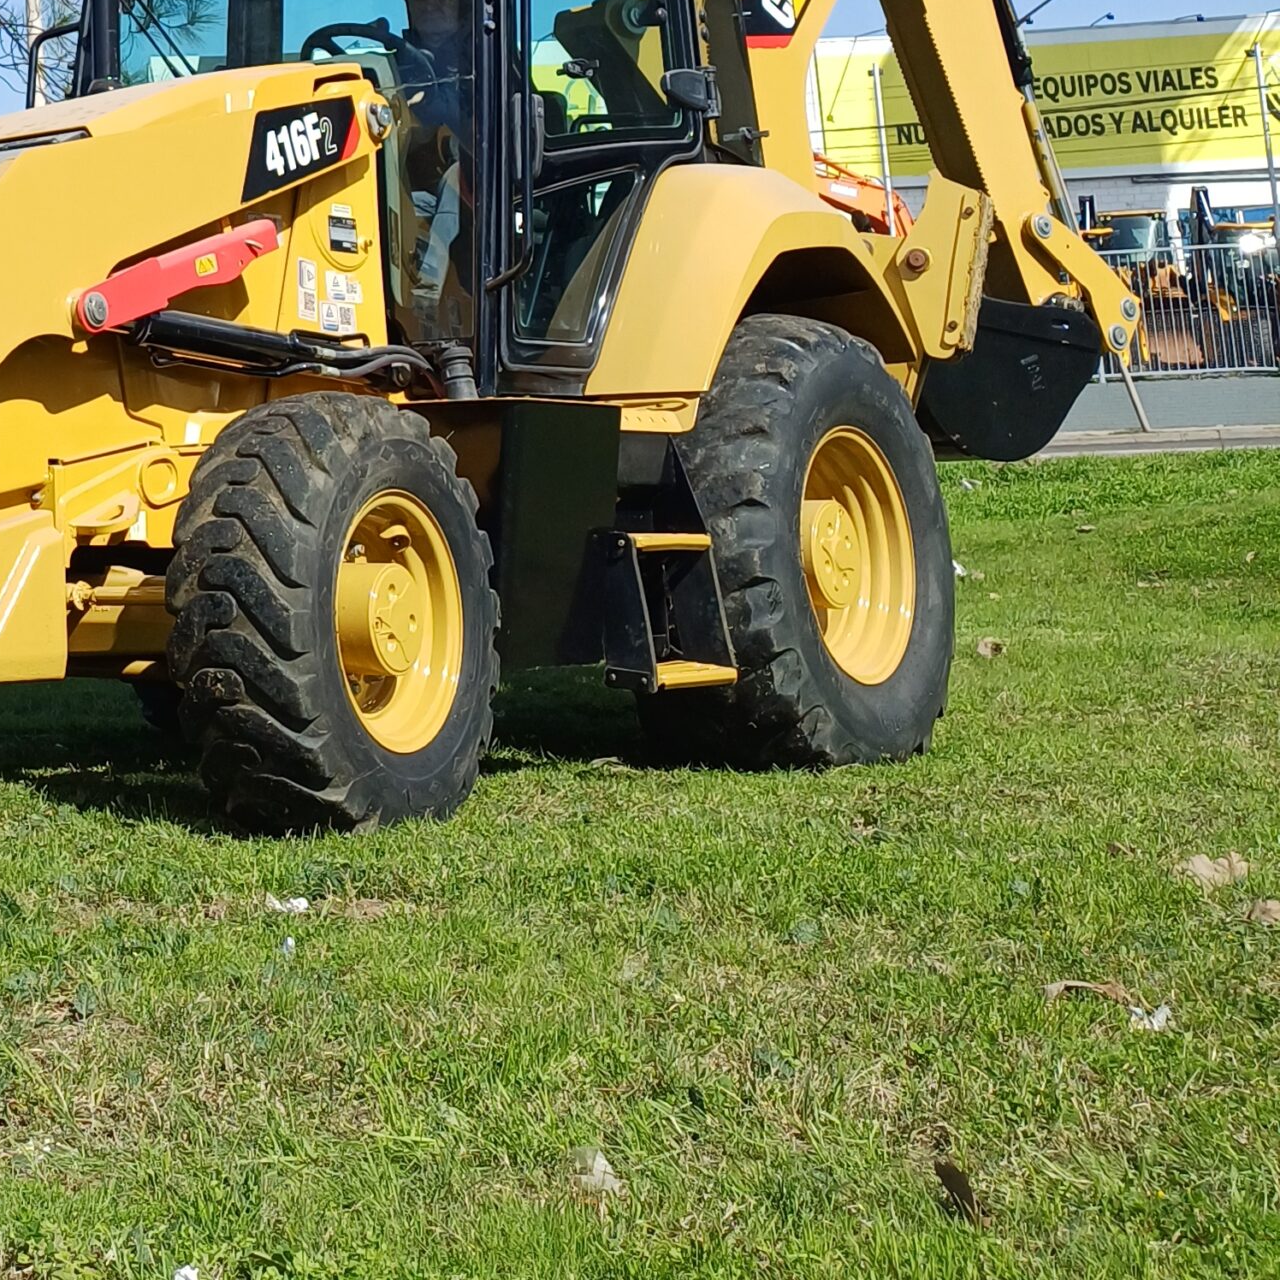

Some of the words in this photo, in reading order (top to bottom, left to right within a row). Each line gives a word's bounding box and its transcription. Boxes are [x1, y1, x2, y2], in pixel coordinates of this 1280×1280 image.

[1033, 71, 1132, 102] EQUIPOS
[1135, 67, 1219, 94] VIALES
[1043, 112, 1106, 139] ADOS
[1109, 111, 1125, 135] Y
[1131, 105, 1249, 136] ALQUILER
[266, 111, 338, 176] 416F2
